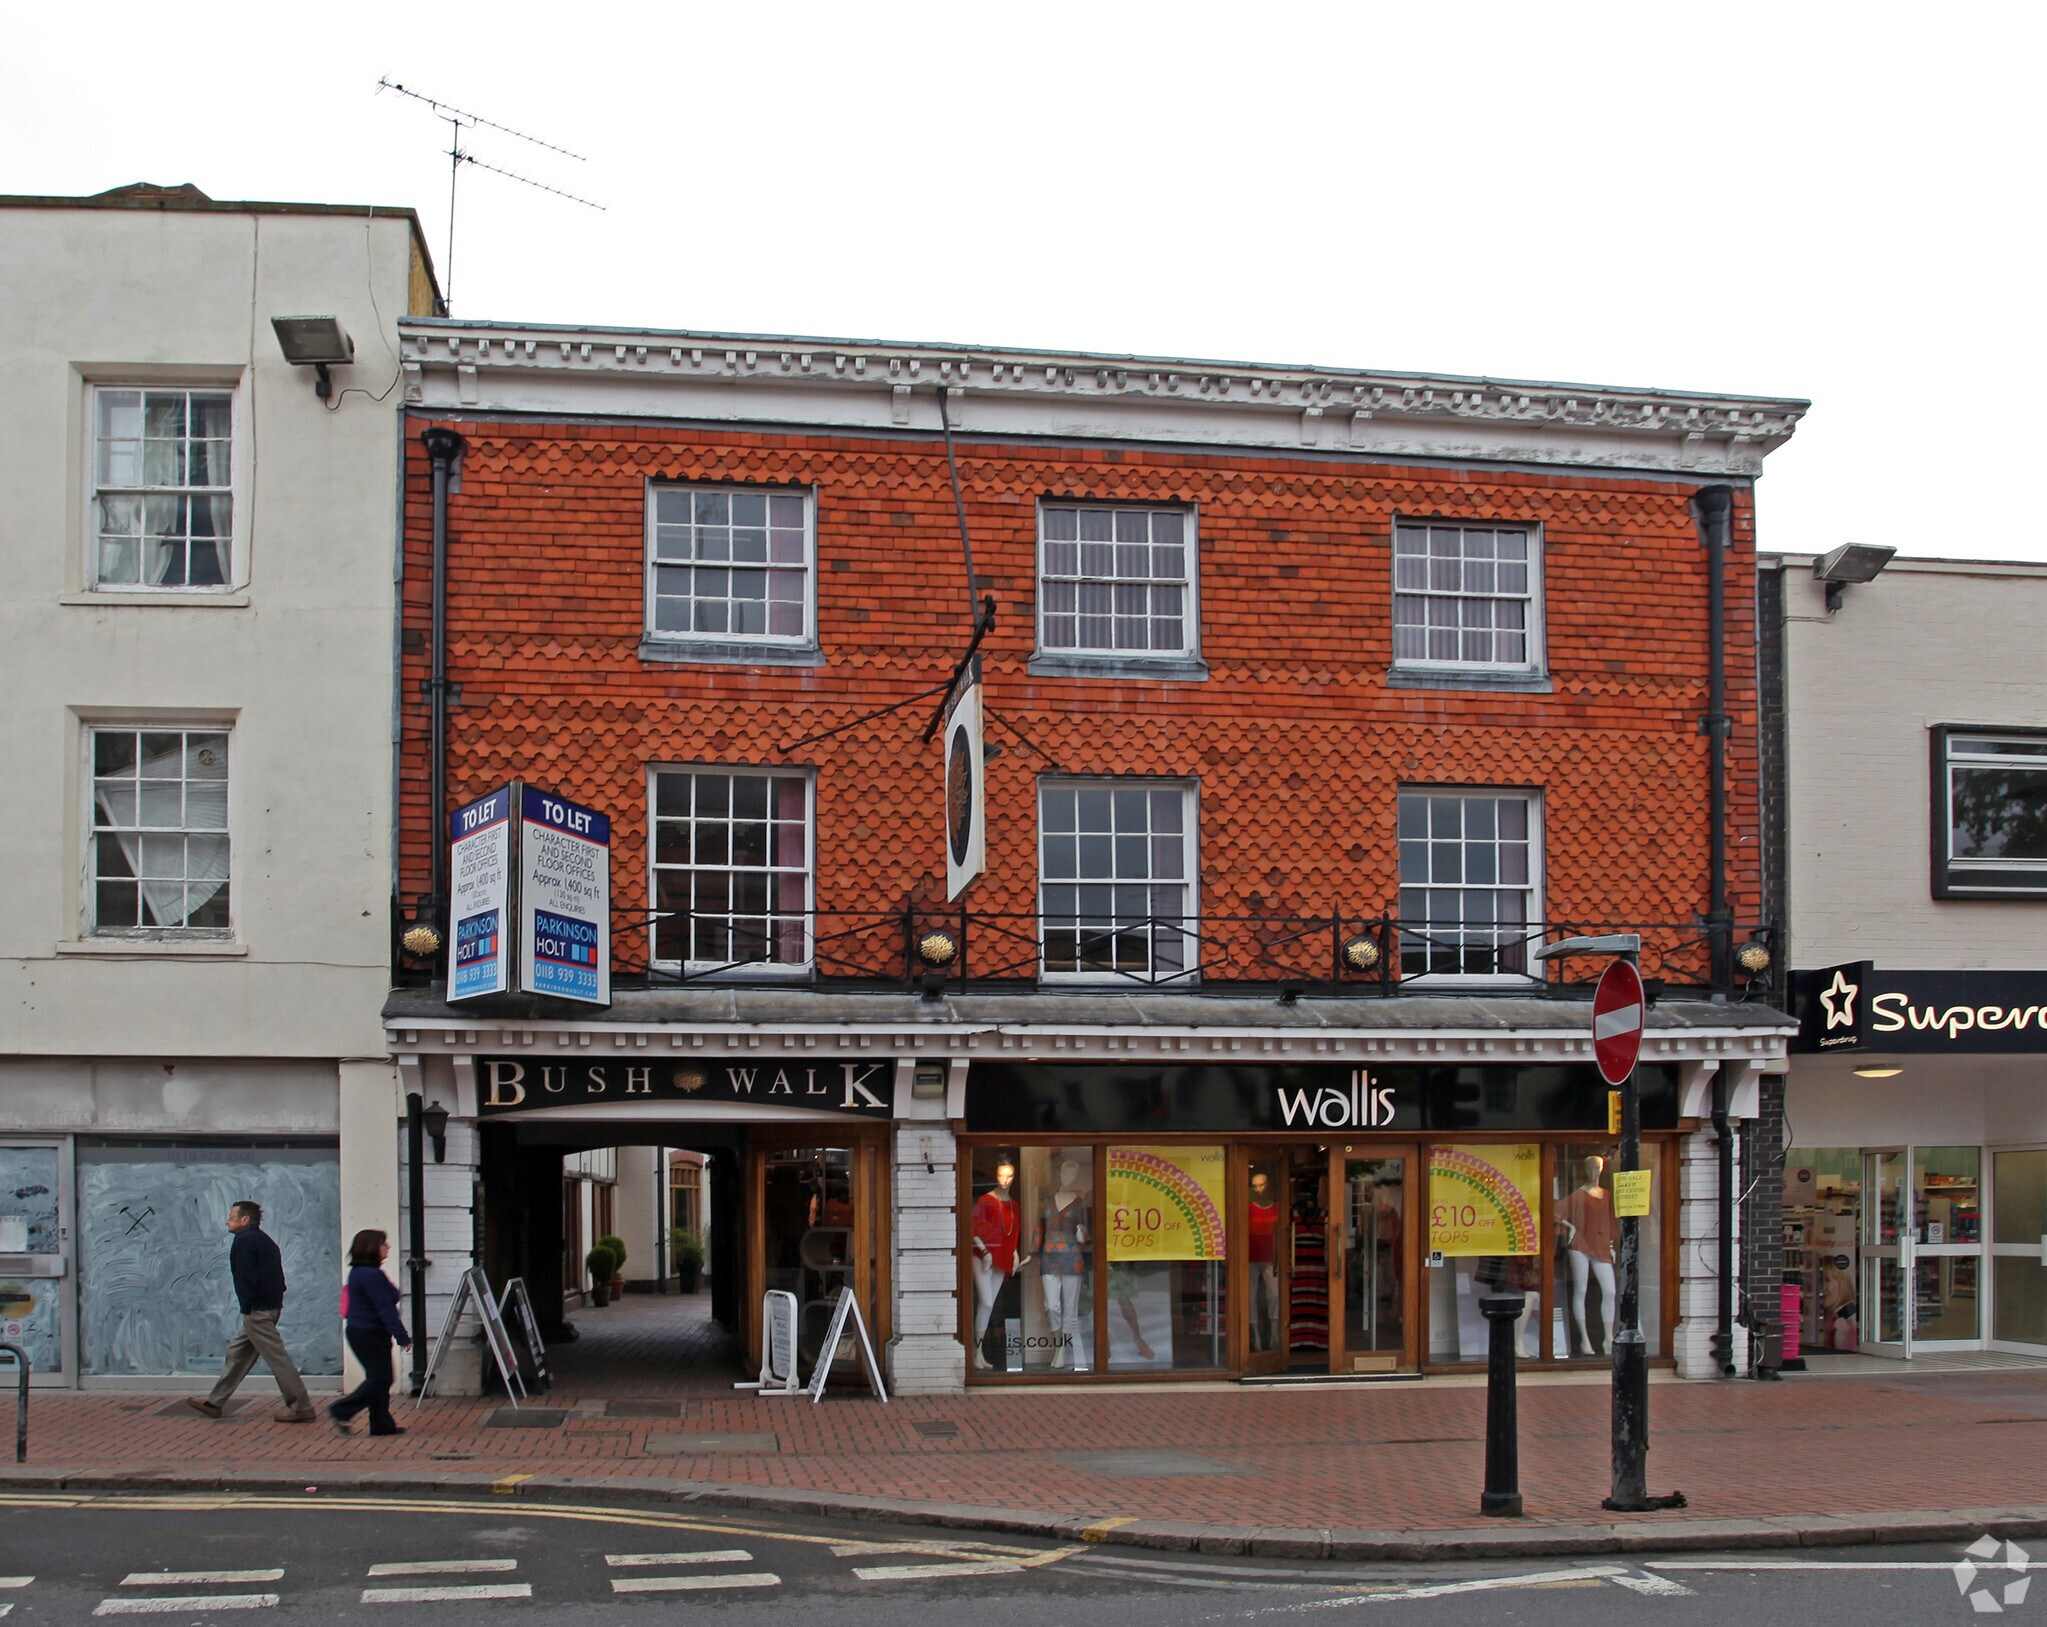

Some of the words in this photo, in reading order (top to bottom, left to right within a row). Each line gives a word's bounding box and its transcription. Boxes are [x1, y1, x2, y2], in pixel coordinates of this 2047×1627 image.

[462, 808, 477, 831] TO
[478, 798, 497, 824] LET
[542, 799, 564, 824] TO
[567, 808, 592, 834] LET
[532, 828, 580, 852] CHARACTER
[581, 844, 600, 860] FIRST
[537, 854, 564, 873] FLOOR
[565, 863, 596, 882] OFFICES
[540, 844, 560, 859] AND
[561, 849, 593, 870] SECOND
[532, 868, 562, 888] Approx
[584, 886, 592, 900] sq
[594, 886, 600, 900] ft
[458, 916, 498, 939] PARKINSON
[536, 915, 597, 944] PARKINSON
[458, 942, 476, 960] HOLT
[536, 937, 566, 958] HOLT
[482, 962, 497, 979] 3333
[535, 963, 554, 980] 0118
[557, 968, 574, 983] 939
[577, 971, 598, 988] 3333
[1872, 992, 2047, 1039] Super
[1819, 1034, 1858, 1047] Superdrug
[1112, 1208, 1162, 1232] £10
[1163, 1222, 1181, 1231] OFF
[1431, 1205, 1476, 1228] £10
[1478, 1218, 1496, 1227] OFF
[1112, 1234, 1155, 1248] TOPS
[1431, 1230, 1469, 1244] TOPS
